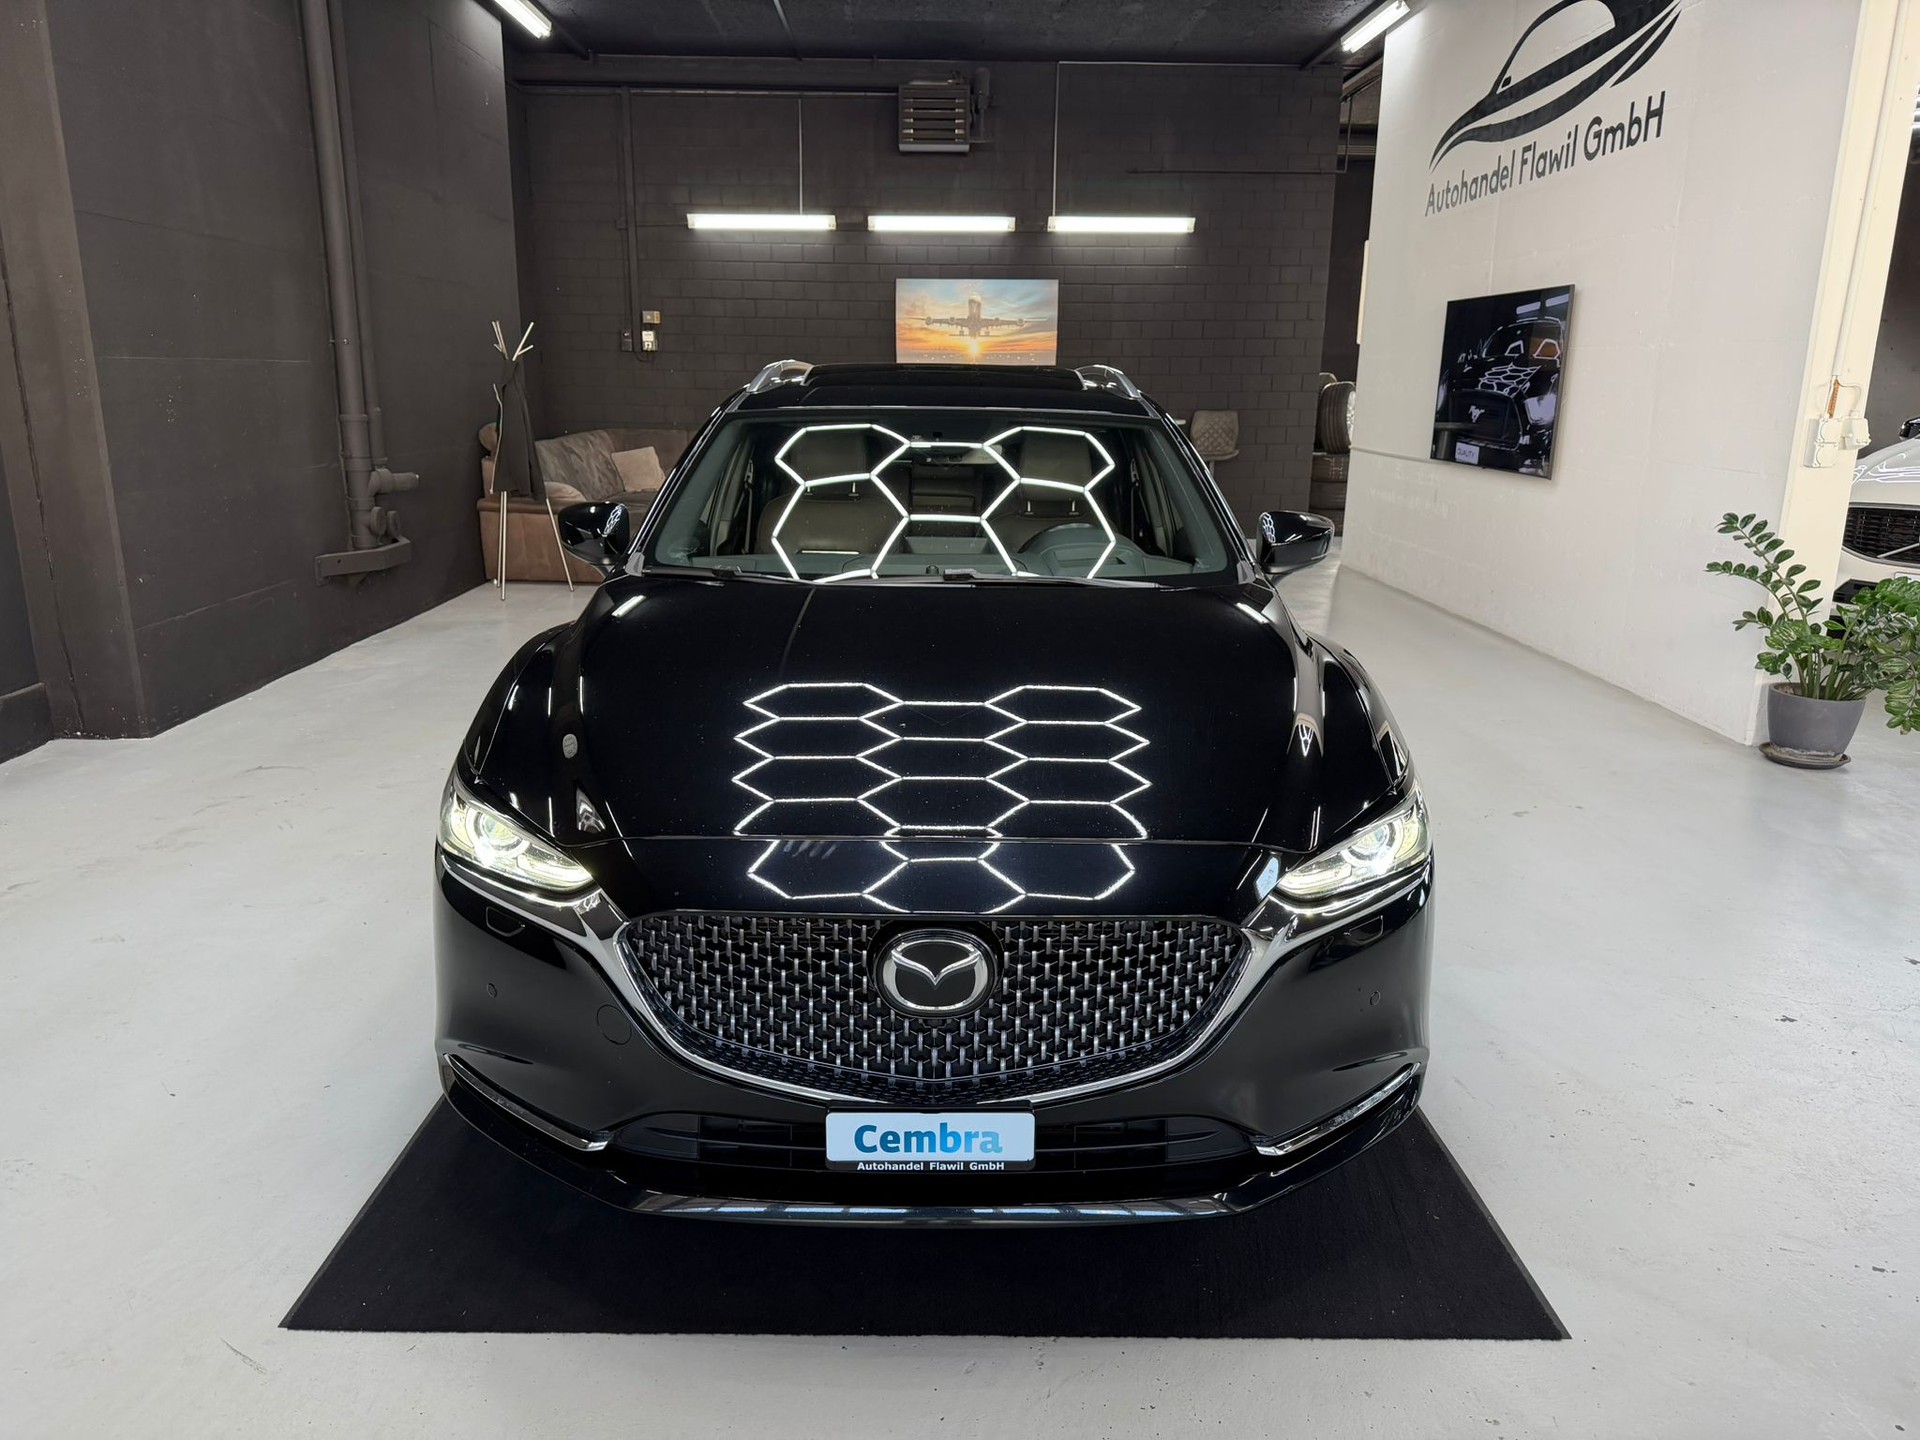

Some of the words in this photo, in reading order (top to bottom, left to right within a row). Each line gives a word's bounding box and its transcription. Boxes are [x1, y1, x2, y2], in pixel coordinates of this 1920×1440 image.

[1424, 149, 1515, 217] Autohandel
[1518, 124, 1579, 185] Flawil
[1583, 90, 1666, 161] GmbH
[854, 1122, 1003, 1154] Cembra
[857, 1161, 924, 1171] Autohandel
[929, 1161, 964, 1171] Flawil
[969, 1161, 1005, 1171] GmbH
